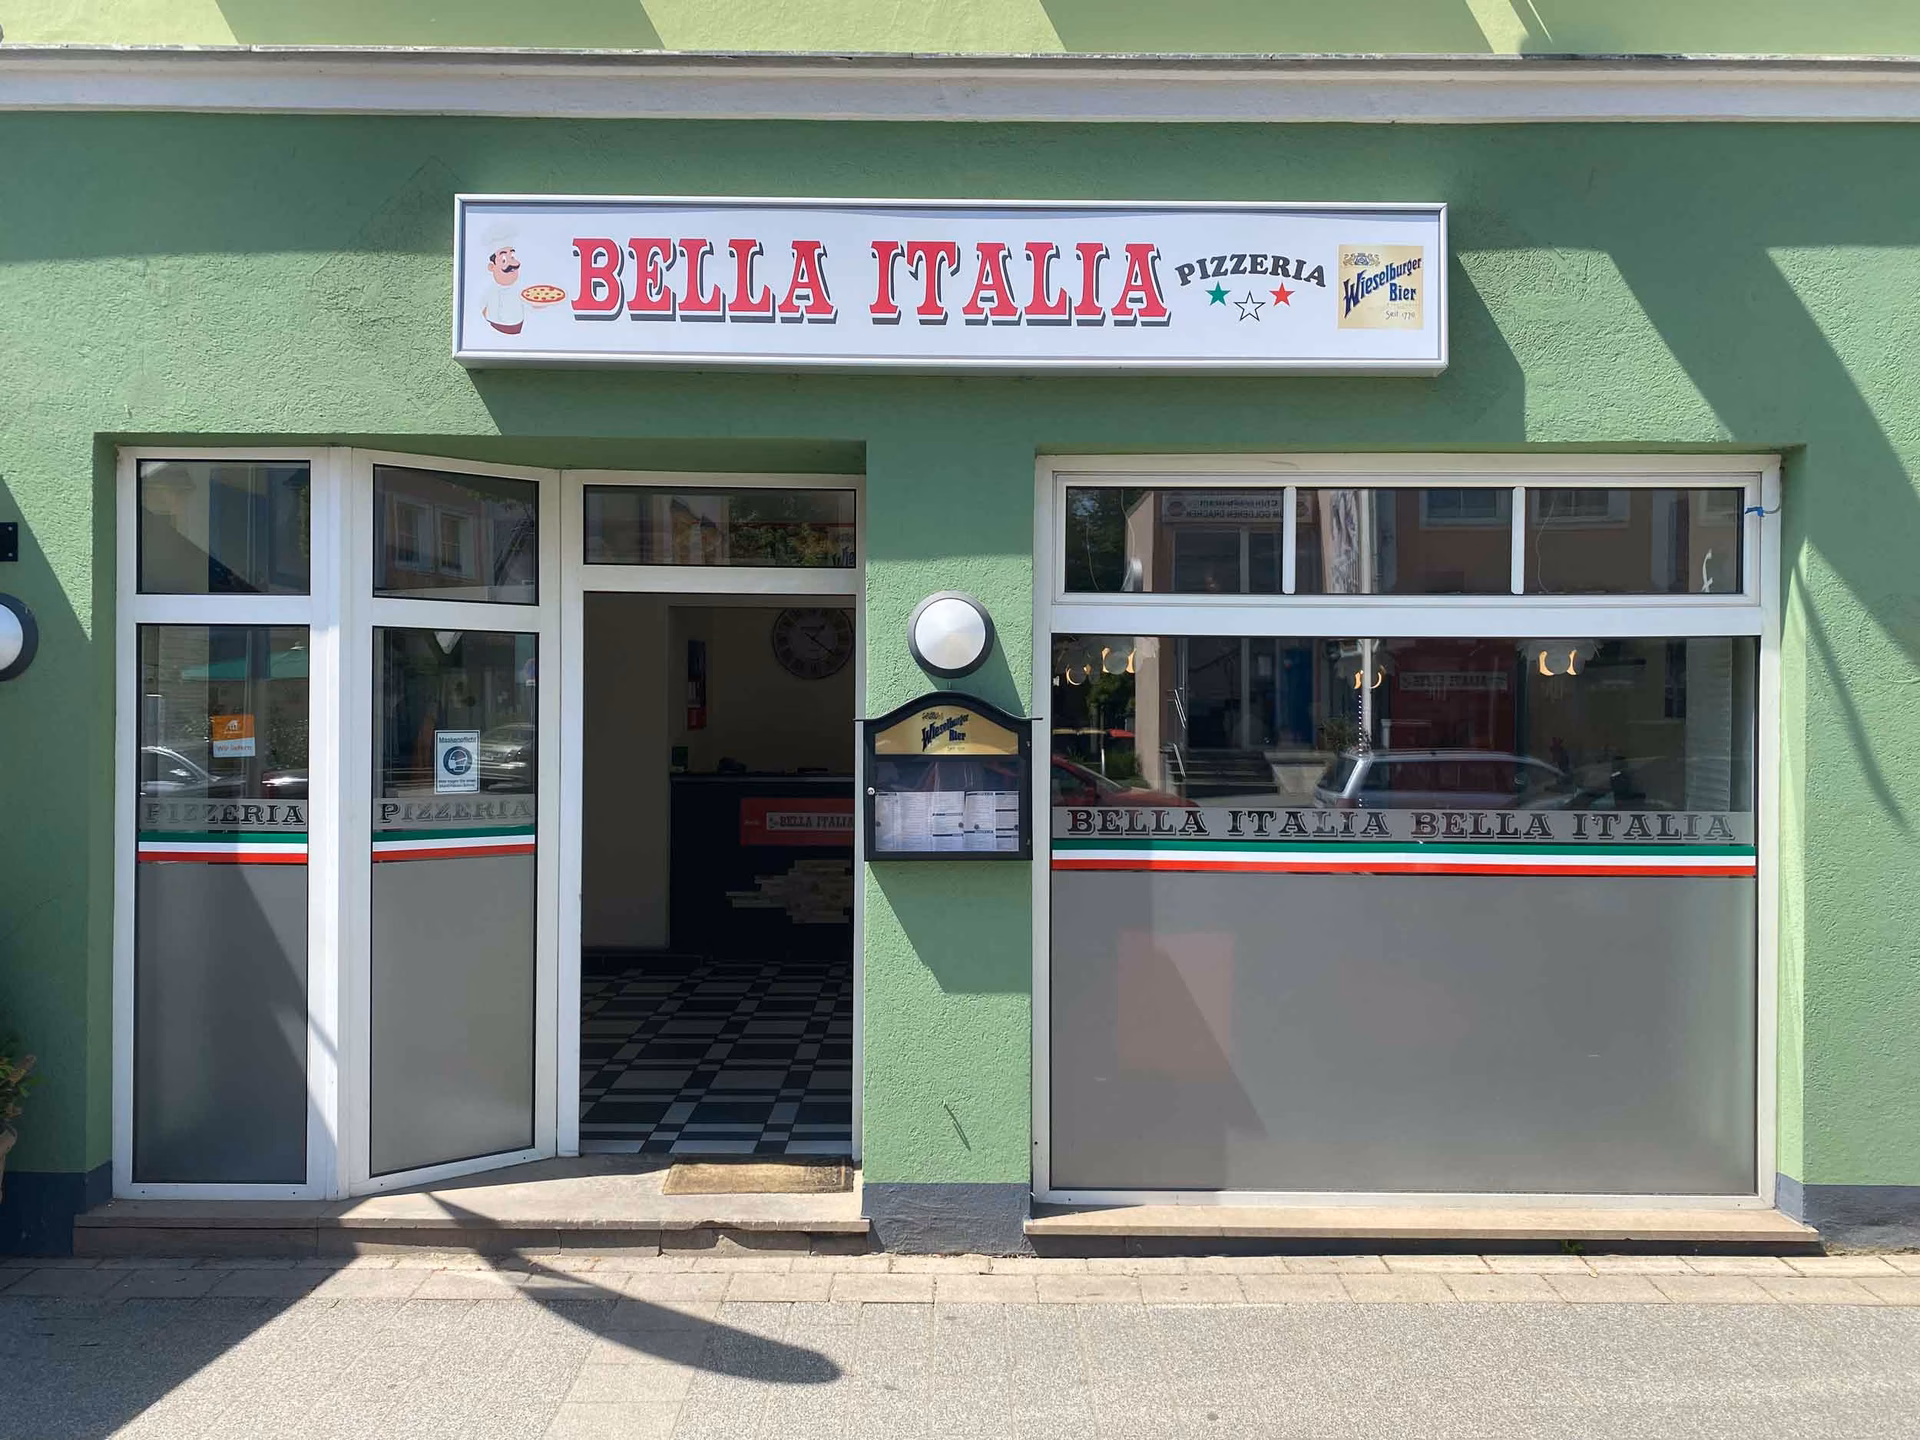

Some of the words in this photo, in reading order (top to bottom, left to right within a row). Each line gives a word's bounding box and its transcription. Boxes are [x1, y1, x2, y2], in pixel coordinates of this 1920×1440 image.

[571, 237, 837, 324] BELLA
[870, 240, 1172, 327] ITALIA
[1174, 253, 1326, 288] PIZZERIA
[1343, 257, 1422, 319] Wieselburger
[1389, 282, 1417, 302] Bier
[145, 803, 306, 826] PIZZERIA
[378, 802, 534, 824] PIZZERIA
[779, 815, 812, 828] BELLA
[1067, 809, 1210, 836] BELLA
[1226, 810, 1393, 837] ITALIA
[1410, 811, 1555, 839] BELLA
[1571, 812, 1736, 840] ITALIA
